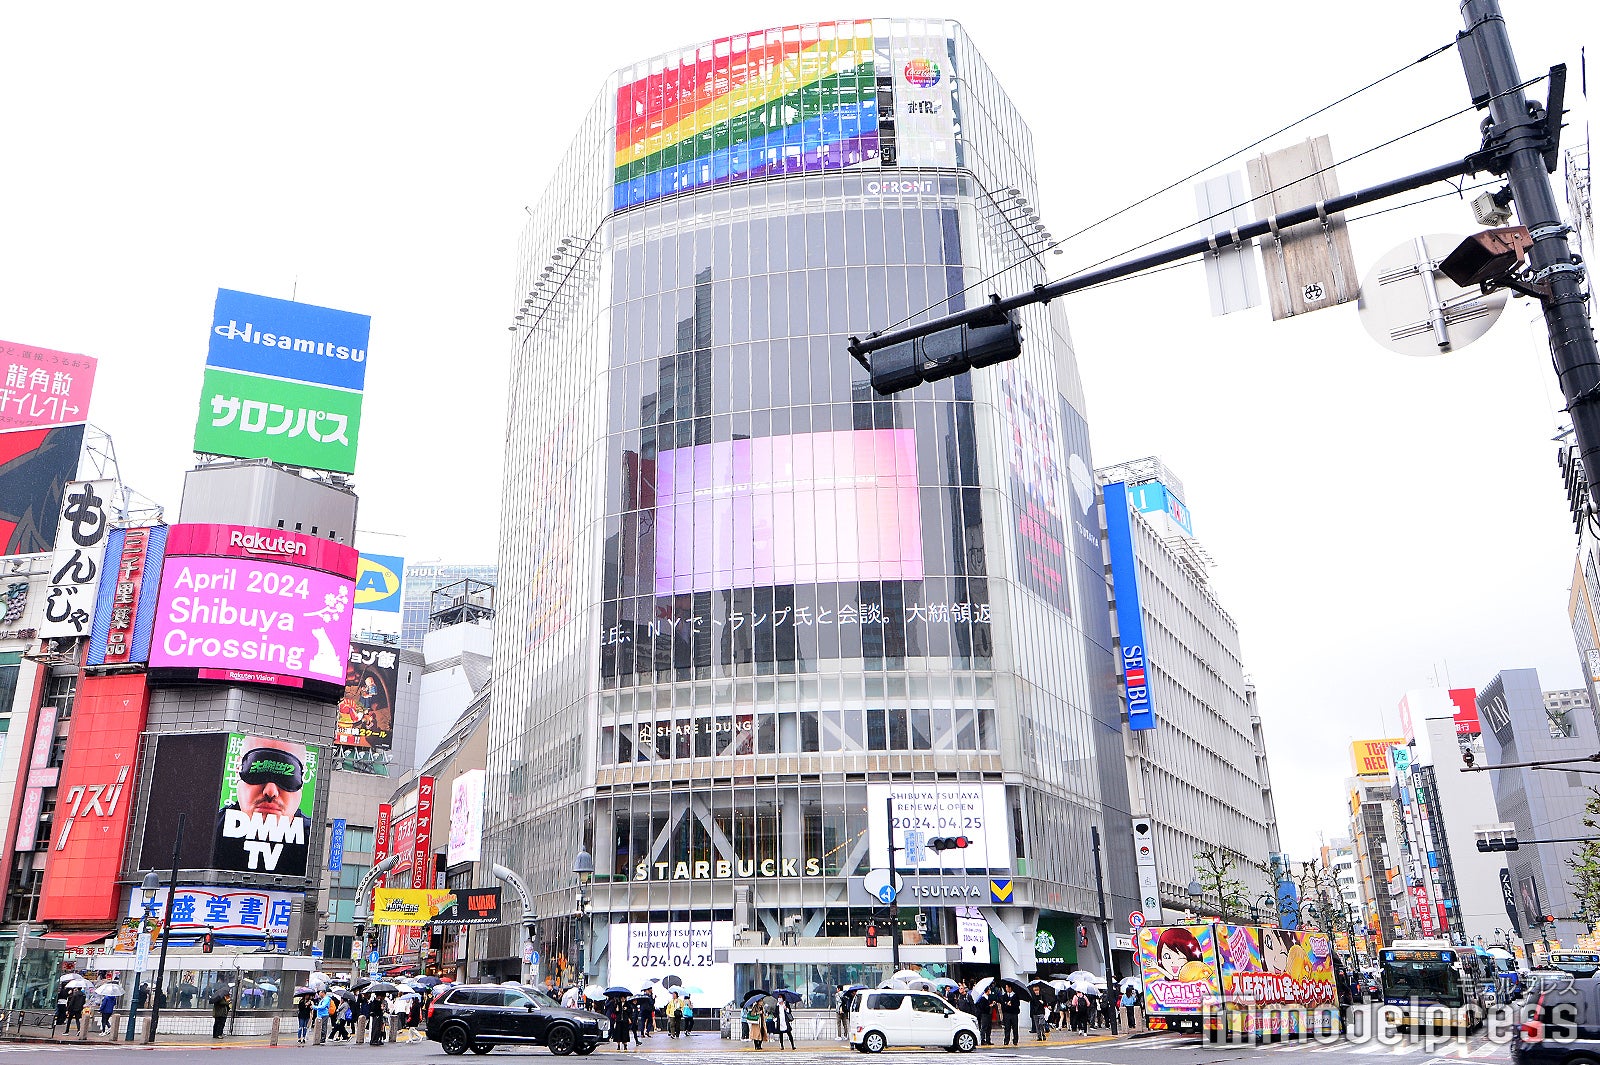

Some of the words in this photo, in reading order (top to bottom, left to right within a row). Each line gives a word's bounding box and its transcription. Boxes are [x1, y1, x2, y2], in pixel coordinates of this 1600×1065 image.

[867, 180, 933, 195] QFRONT
[214, 320, 365, 363] Hisamitsu
[6, 363, 74, 397] 龍角散
[210, 394, 349, 447] サロンパス
[46, 483, 107, 634] もんじゃ
[230, 531, 307, 556] Rakuten
[173, 566, 237, 593] April
[246, 570, 310, 600] 2024
[168, 596, 295, 633] Shibuya
[162, 628, 305, 671] Crossing
[255, 674, 276, 684] Vision
[1123, 644, 1150, 717] SEIBU
[1484, 692, 1511, 733] ZAR
[656, 724, 699, 737] SHARE
[891, 792, 934, 801] SHIBUYA
[936, 791, 980, 800] TSUTAYA
[897, 803, 945, 811] RENEWAL
[947, 803, 975, 811] OPEN
[222, 808, 304, 845] DMM
[416, 784, 433, 844] カラオケ
[892, 817, 982, 829] 2024.04.25
[243, 840, 284, 871] TV
[635, 858, 821, 881] STARBUCKS
[911, 885, 981, 897] TSUTAYA
[1501, 873, 1514, 905] ZARA
[633, 929, 671, 938] SHIBUYA
[673, 929, 713, 938] TSUTAYA
[682, 940, 708, 949] OPEN
[632, 955, 714, 967] 2024.04.25
